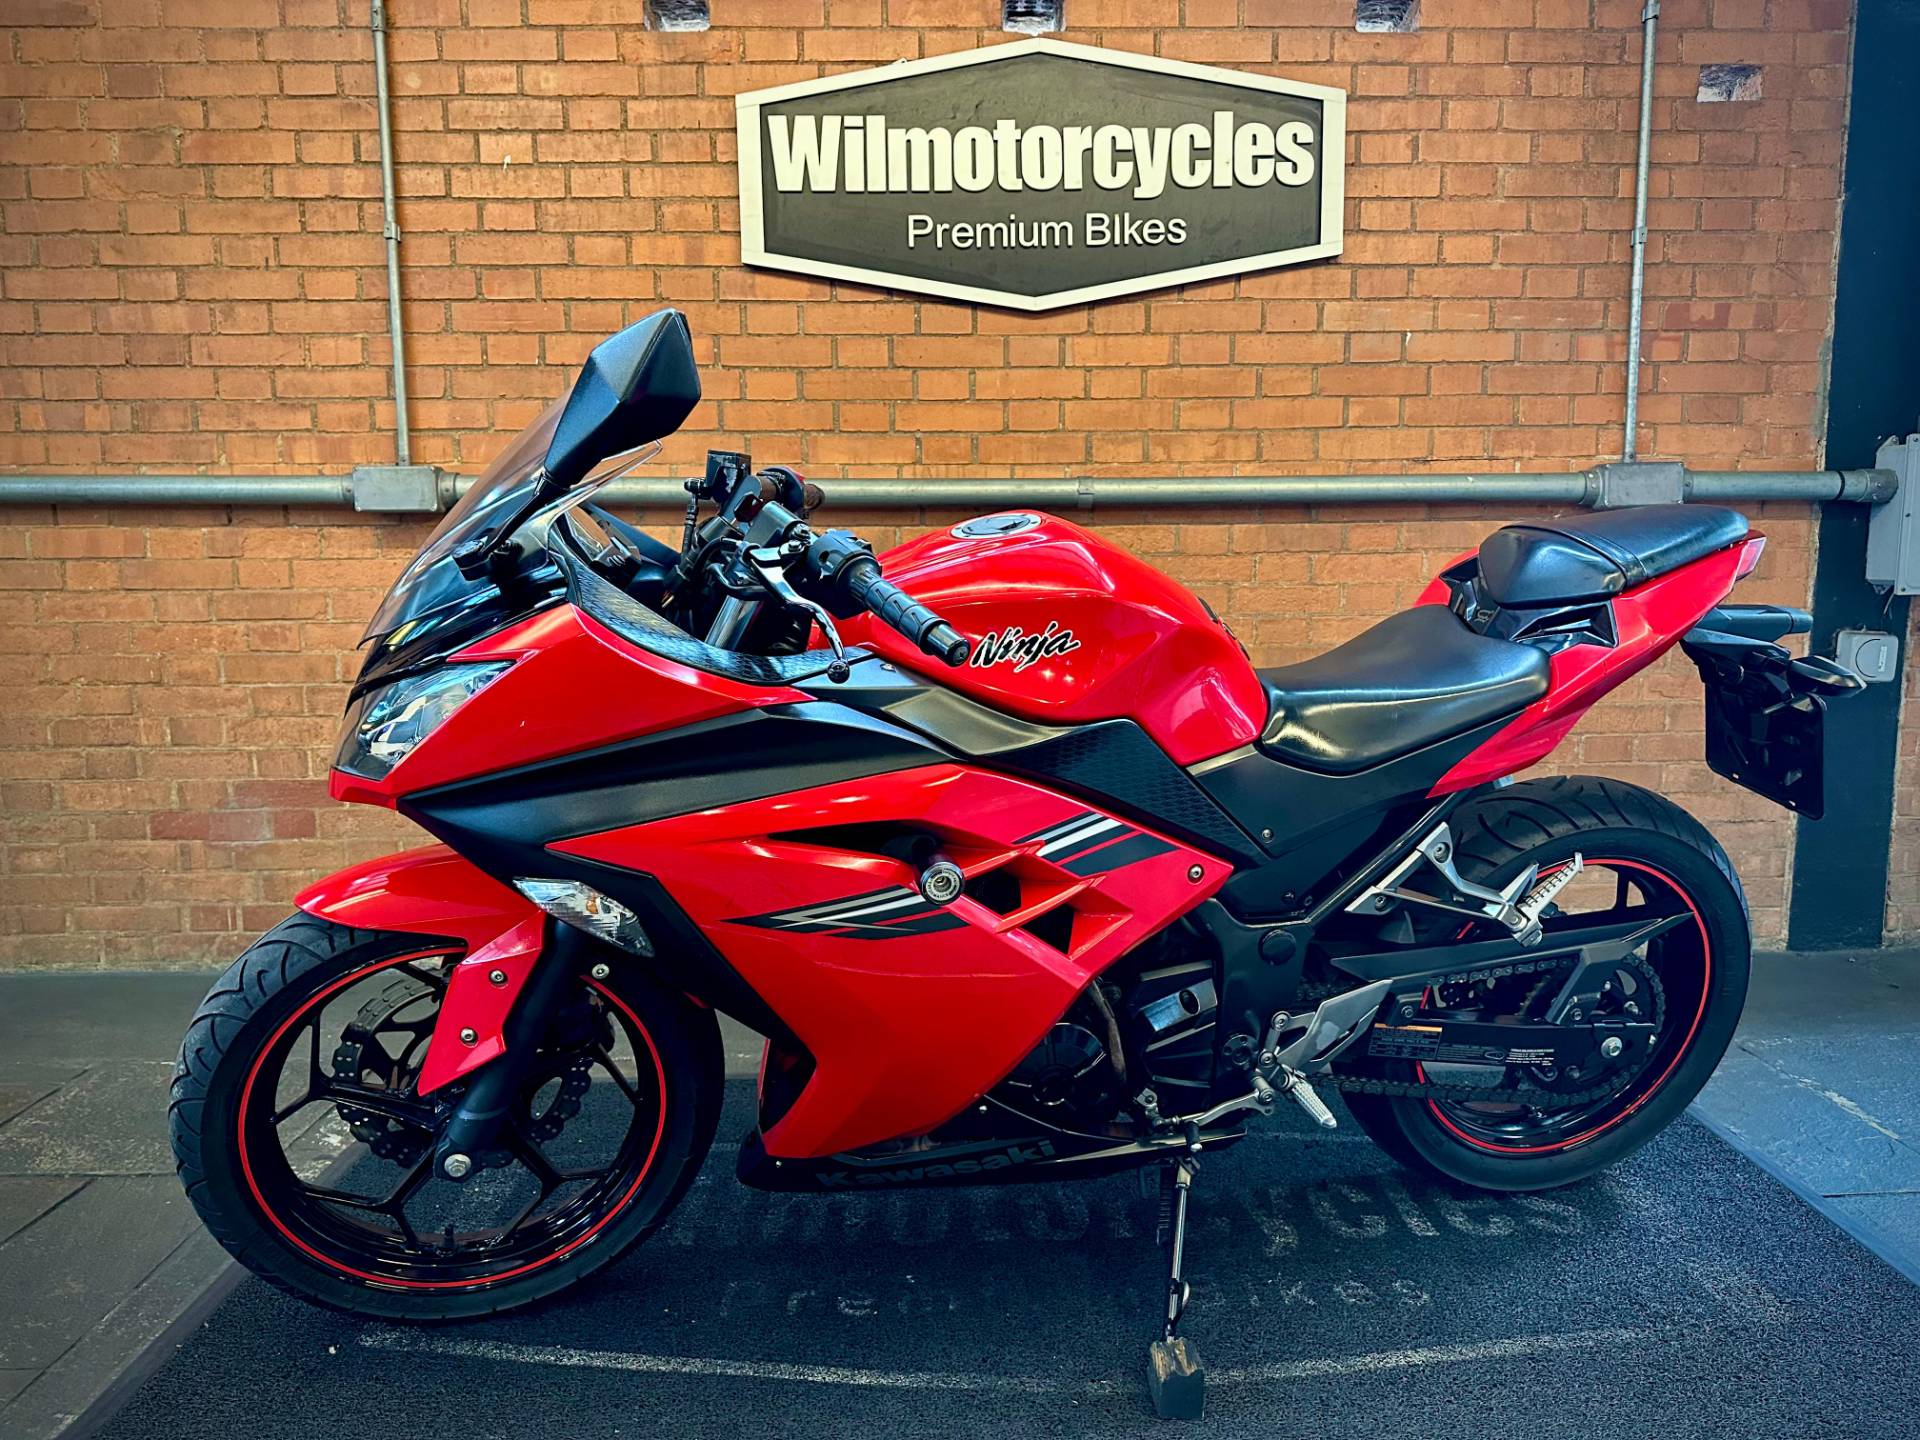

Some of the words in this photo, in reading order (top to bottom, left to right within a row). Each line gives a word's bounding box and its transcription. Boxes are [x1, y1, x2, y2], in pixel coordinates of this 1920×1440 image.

[767, 111, 1315, 198] Wilmotorcycles
[906, 213, 1074, 249] Premium
[970, 620, 1081, 673] Ninja
[815, 1139, 1056, 1187] Kawasaki
